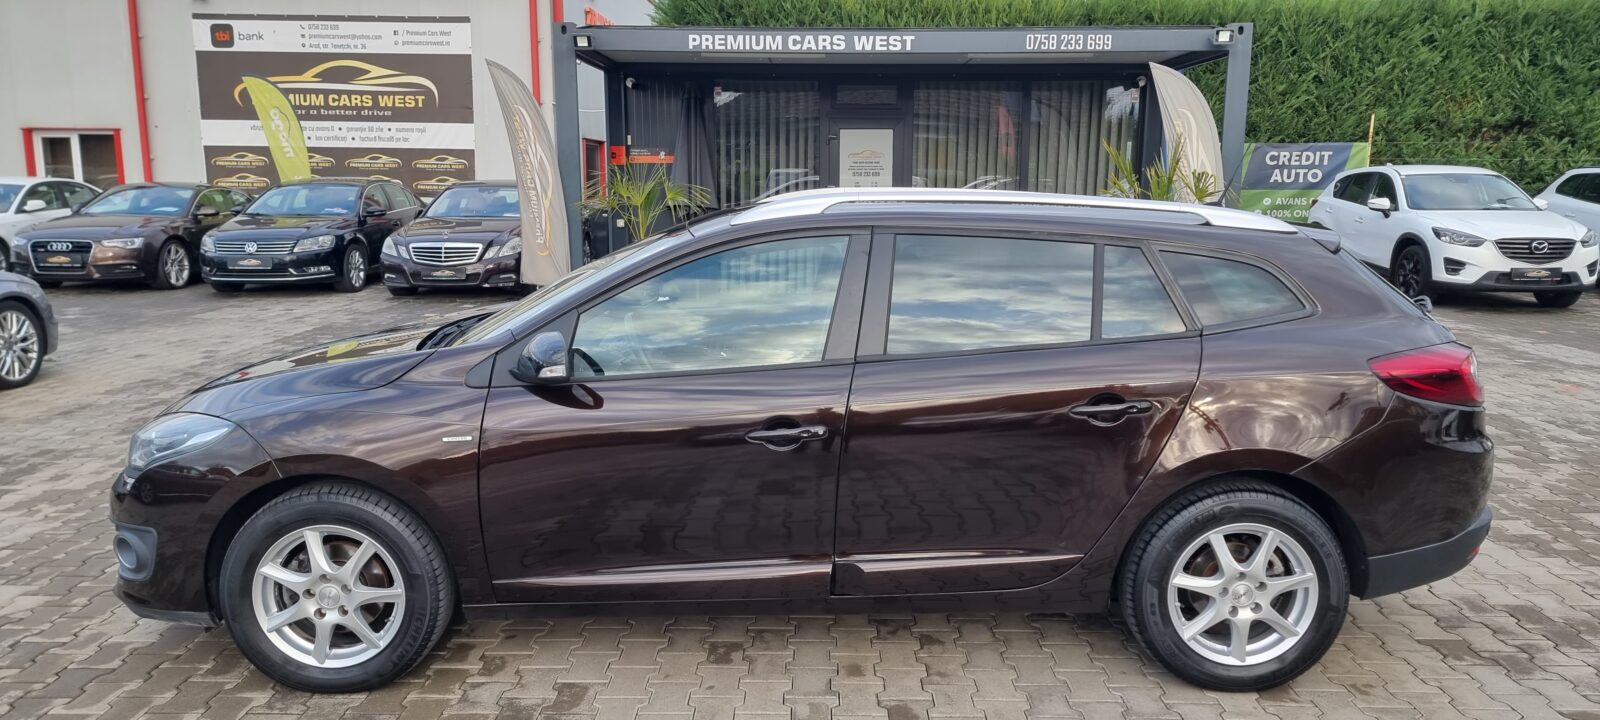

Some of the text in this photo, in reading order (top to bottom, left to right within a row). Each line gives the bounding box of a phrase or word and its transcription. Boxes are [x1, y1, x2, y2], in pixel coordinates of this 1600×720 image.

[238, 32, 264, 40] bank
[688, 34, 916, 51] PREMIUM CARS WEST
[1026, 34, 1112, 49] 0758 233 699
[289, 94, 425, 107] MIUM CARS WEST
[1265, 151, 1333, 165] CREDIT
[1270, 169, 1323, 183] AUTO
[1275, 198, 1307, 206] AVANS
[1266, 209, 1291, 217] 100%
